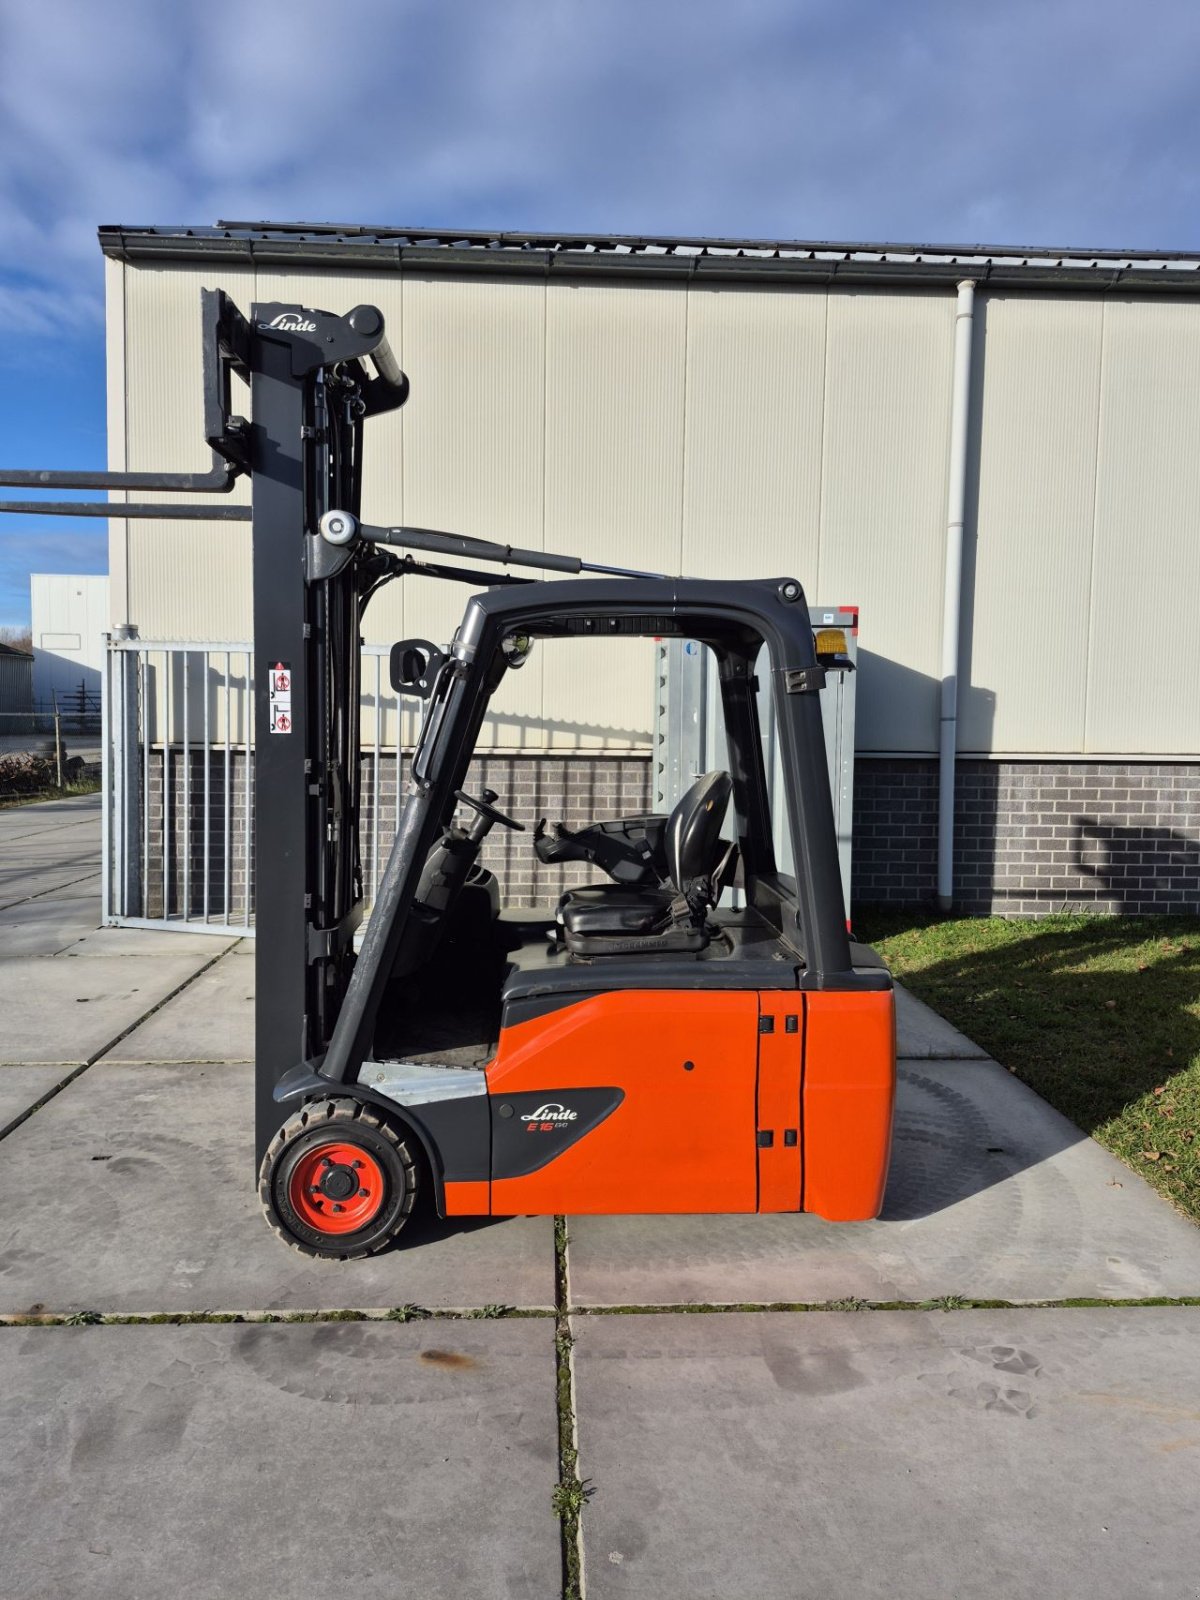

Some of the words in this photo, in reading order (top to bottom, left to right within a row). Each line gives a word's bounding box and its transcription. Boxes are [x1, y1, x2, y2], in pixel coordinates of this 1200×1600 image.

[258, 313, 317, 332] Linde
[520, 1103, 578, 1121] Linde
[527, 1122, 538, 1132] E
[540, 1122, 554, 1132] 16
